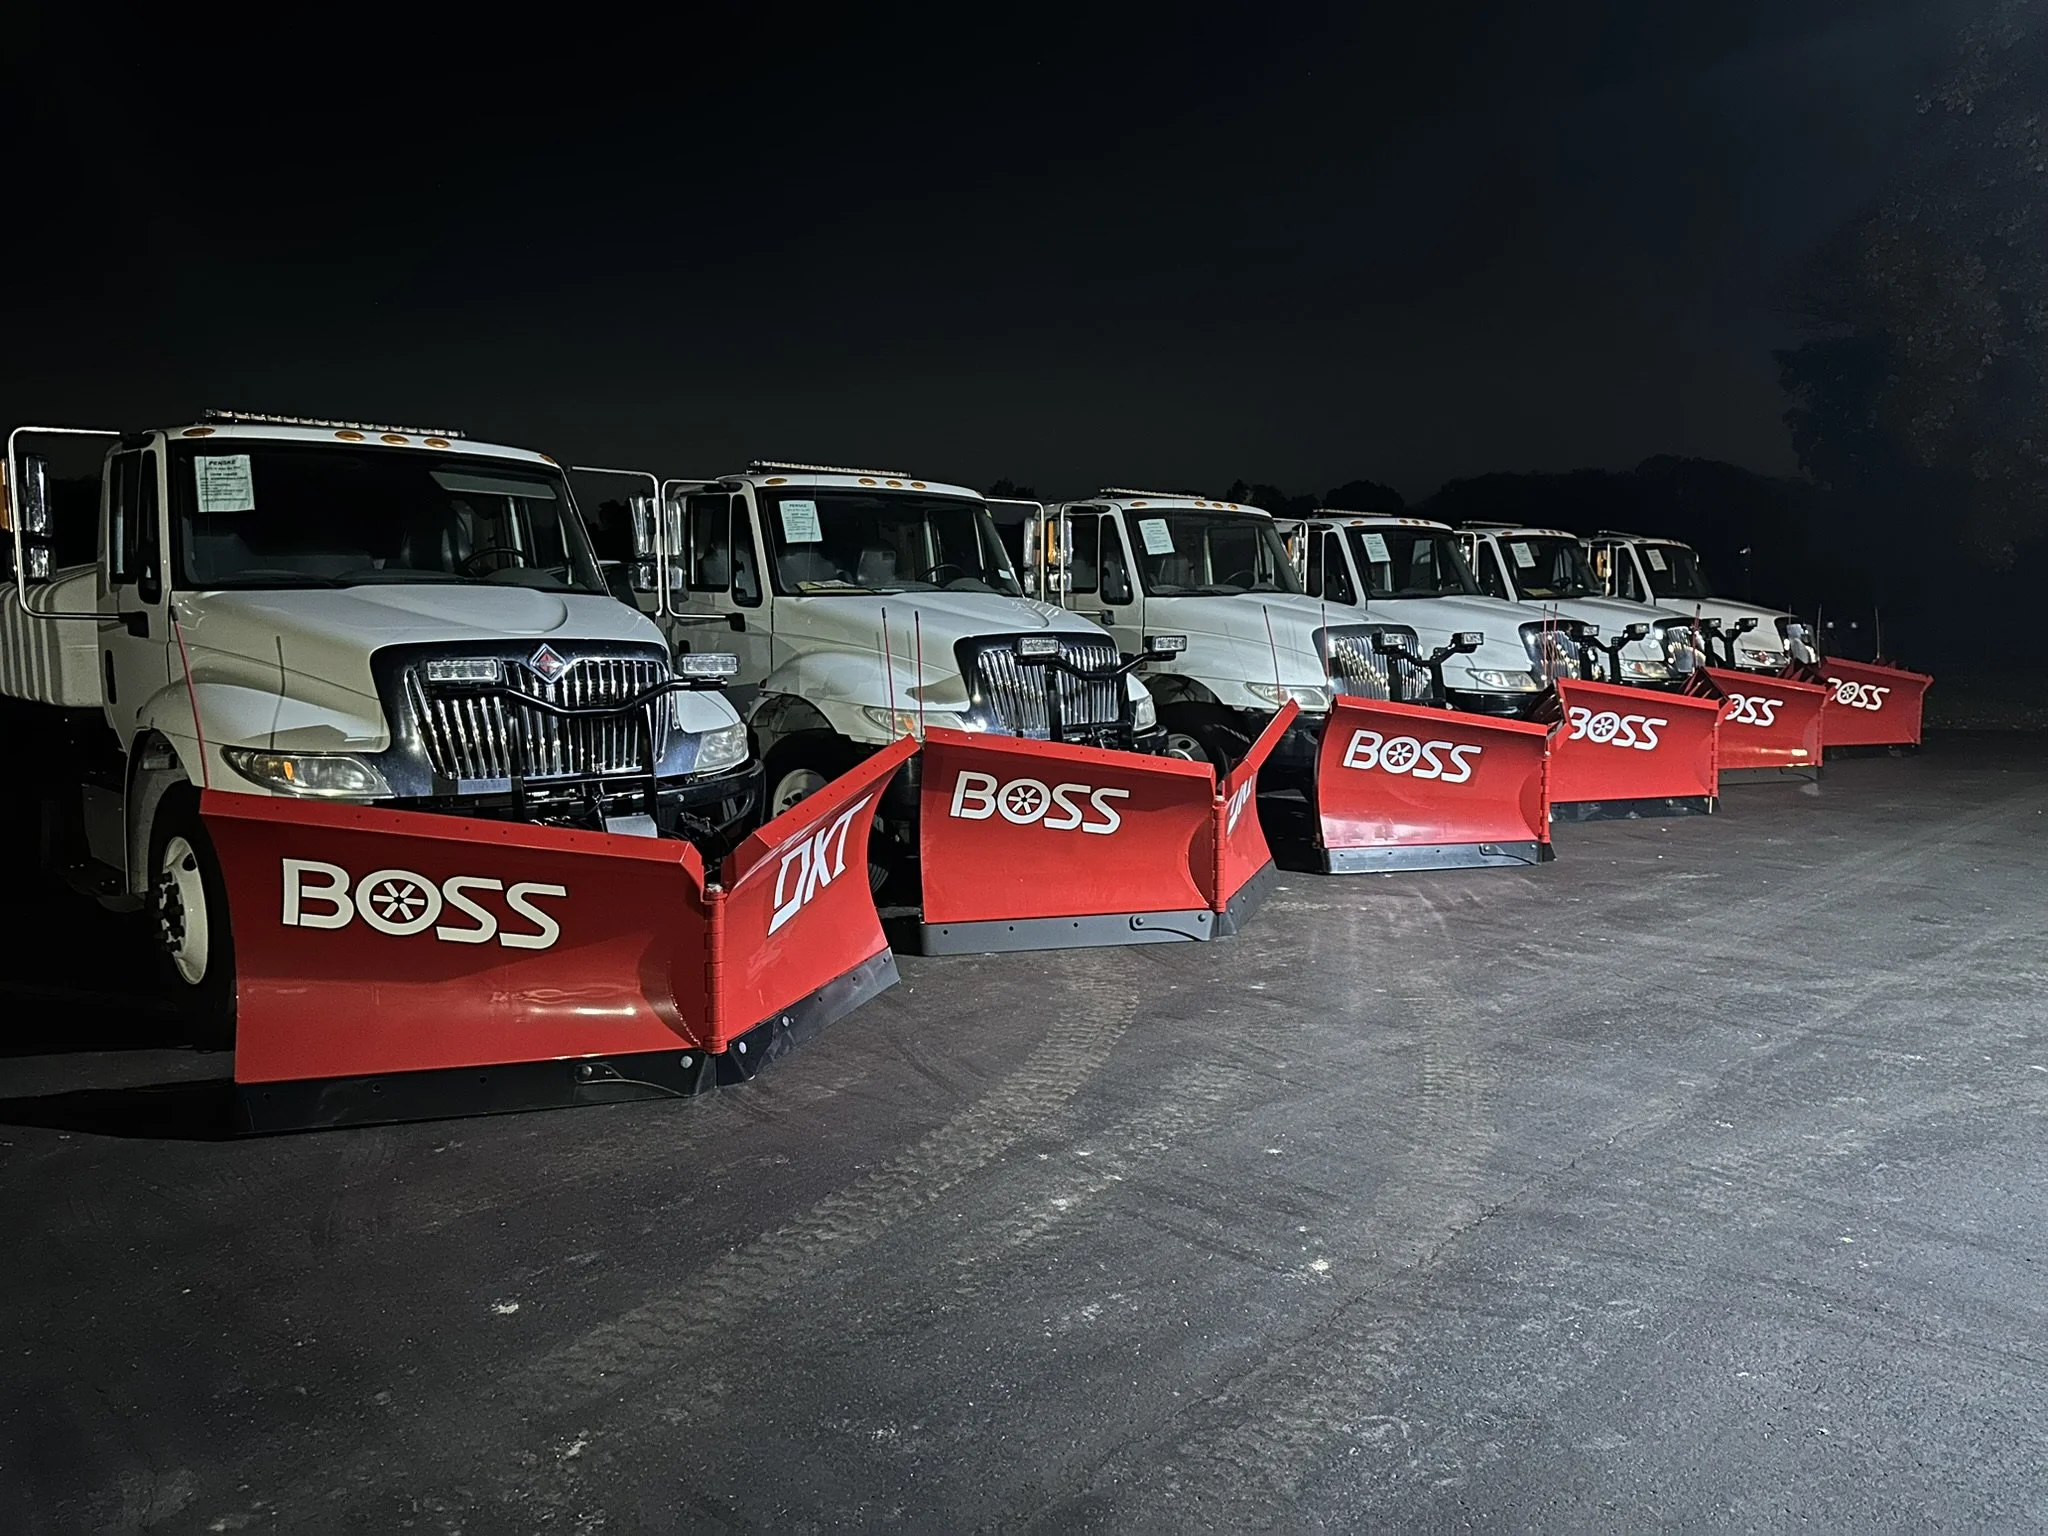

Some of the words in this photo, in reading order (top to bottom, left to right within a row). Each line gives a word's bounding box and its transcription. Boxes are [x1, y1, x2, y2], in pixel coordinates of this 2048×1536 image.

[1342, 729, 1482, 784] BOSS
[949, 770, 1130, 835] BOSS
[282, 857, 567, 950] BOSS
